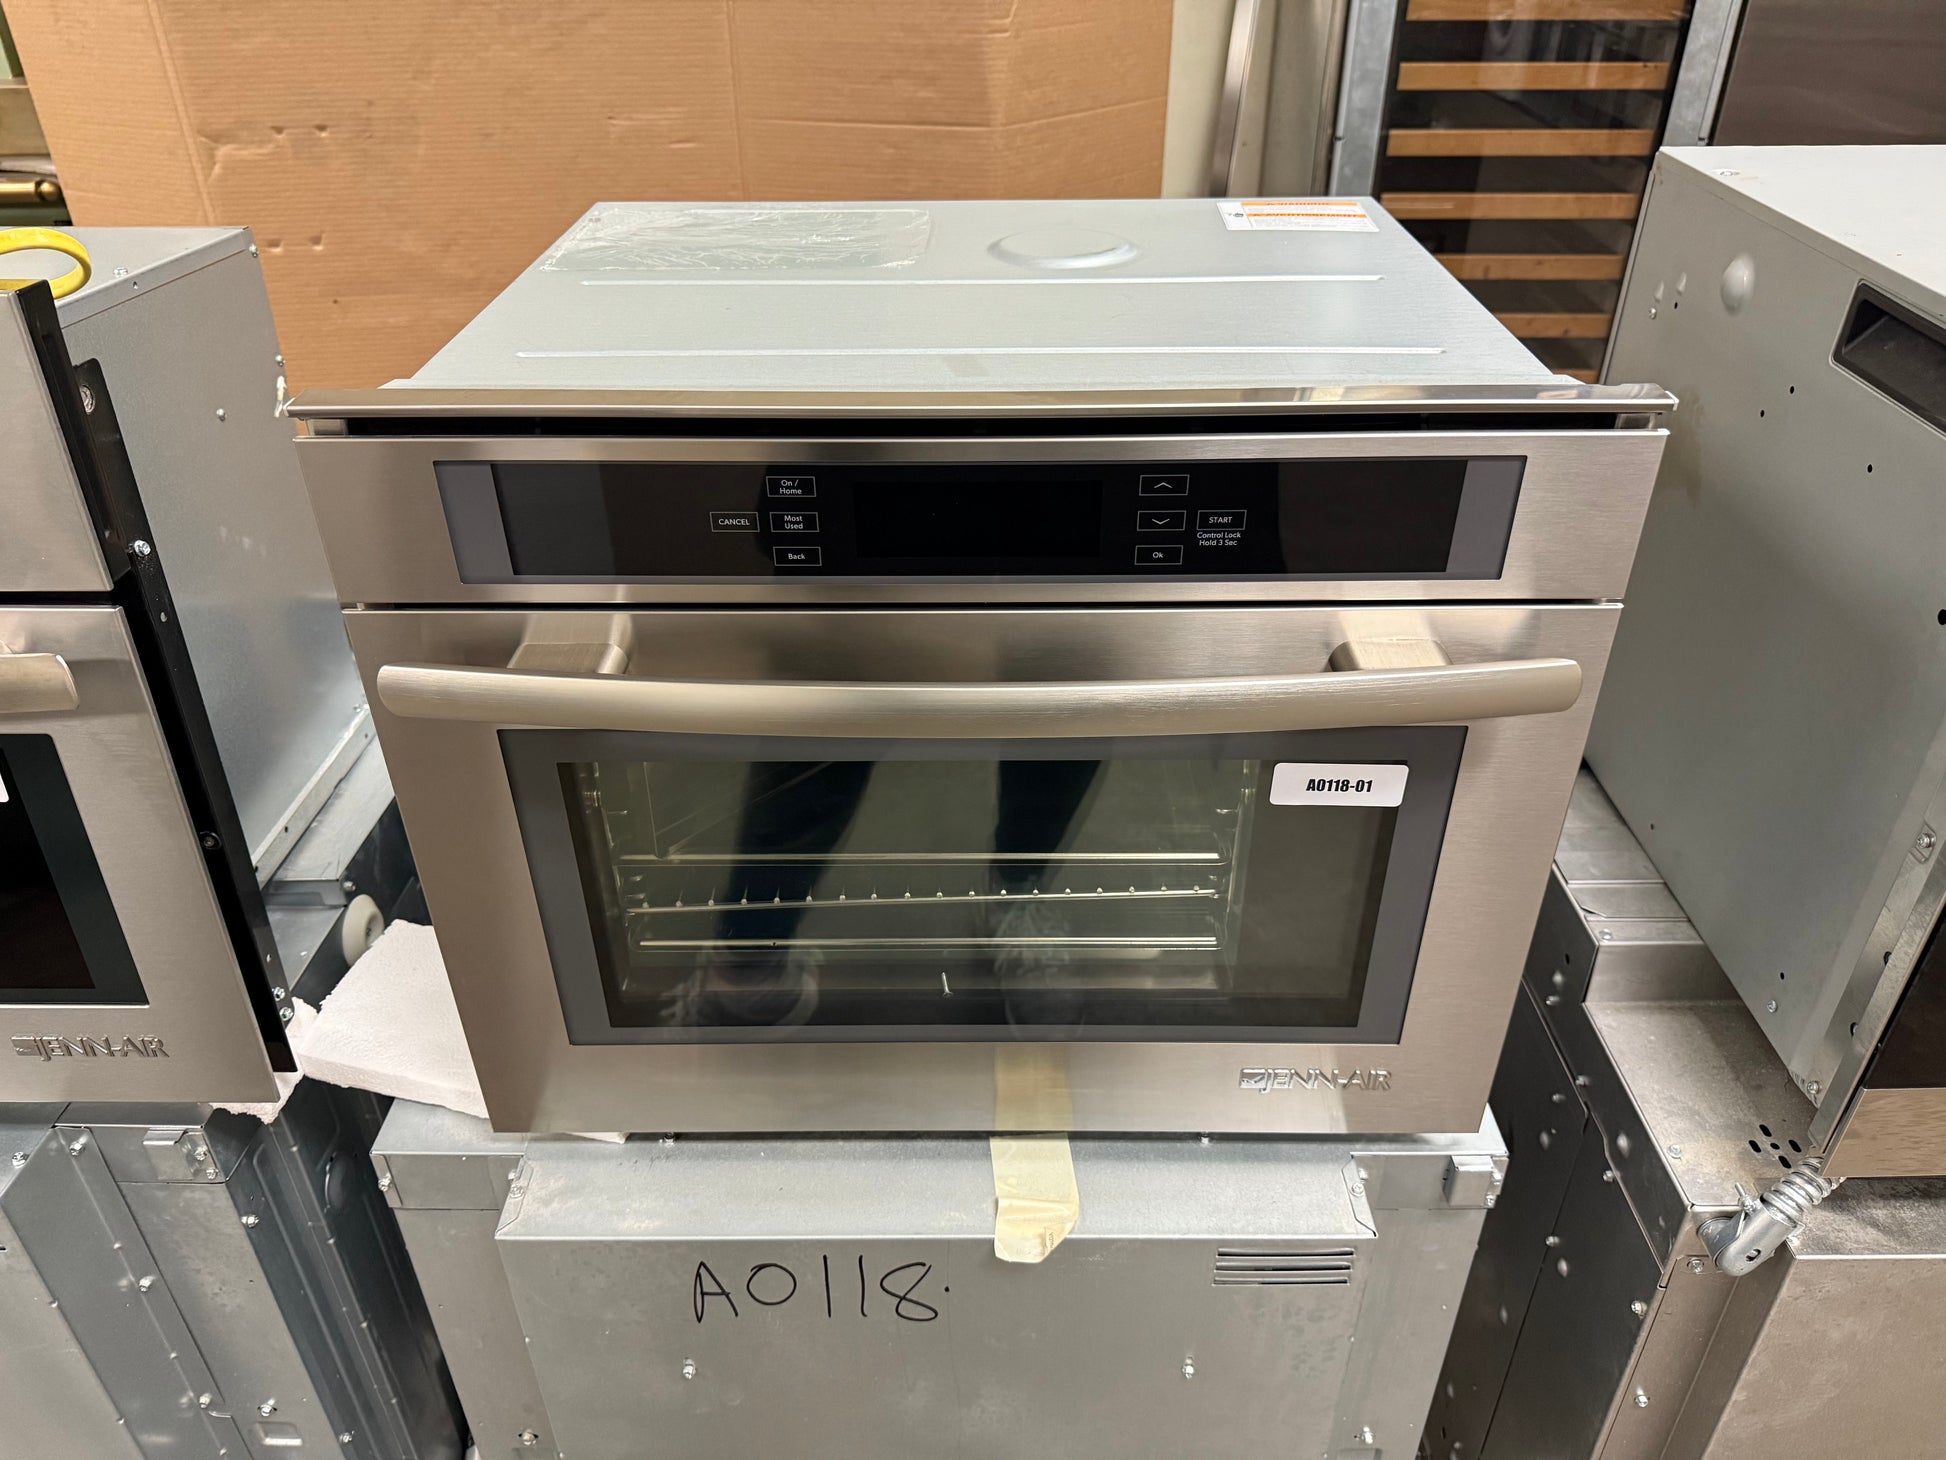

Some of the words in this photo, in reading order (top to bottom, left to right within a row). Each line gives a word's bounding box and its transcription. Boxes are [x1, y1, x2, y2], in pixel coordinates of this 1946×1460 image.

[780, 479, 793, 487] On
[779, 487, 802, 495] Home
[718, 518, 751, 526] CANCEL
[1208, 516, 1233, 524] START
[784, 522, 804, 530] Used
[1196, 531, 1224, 539] Control
[1225, 531, 1241, 539] Lock
[1199, 539, 1217, 547] Hold
[1152, 551, 1164, 559] Ok
[1305, 778, 1373, 793] A0118-01
[40, 1034, 170, 1062] JENN-AIR
[1259, 1068, 1392, 1093] JENN-AIR
